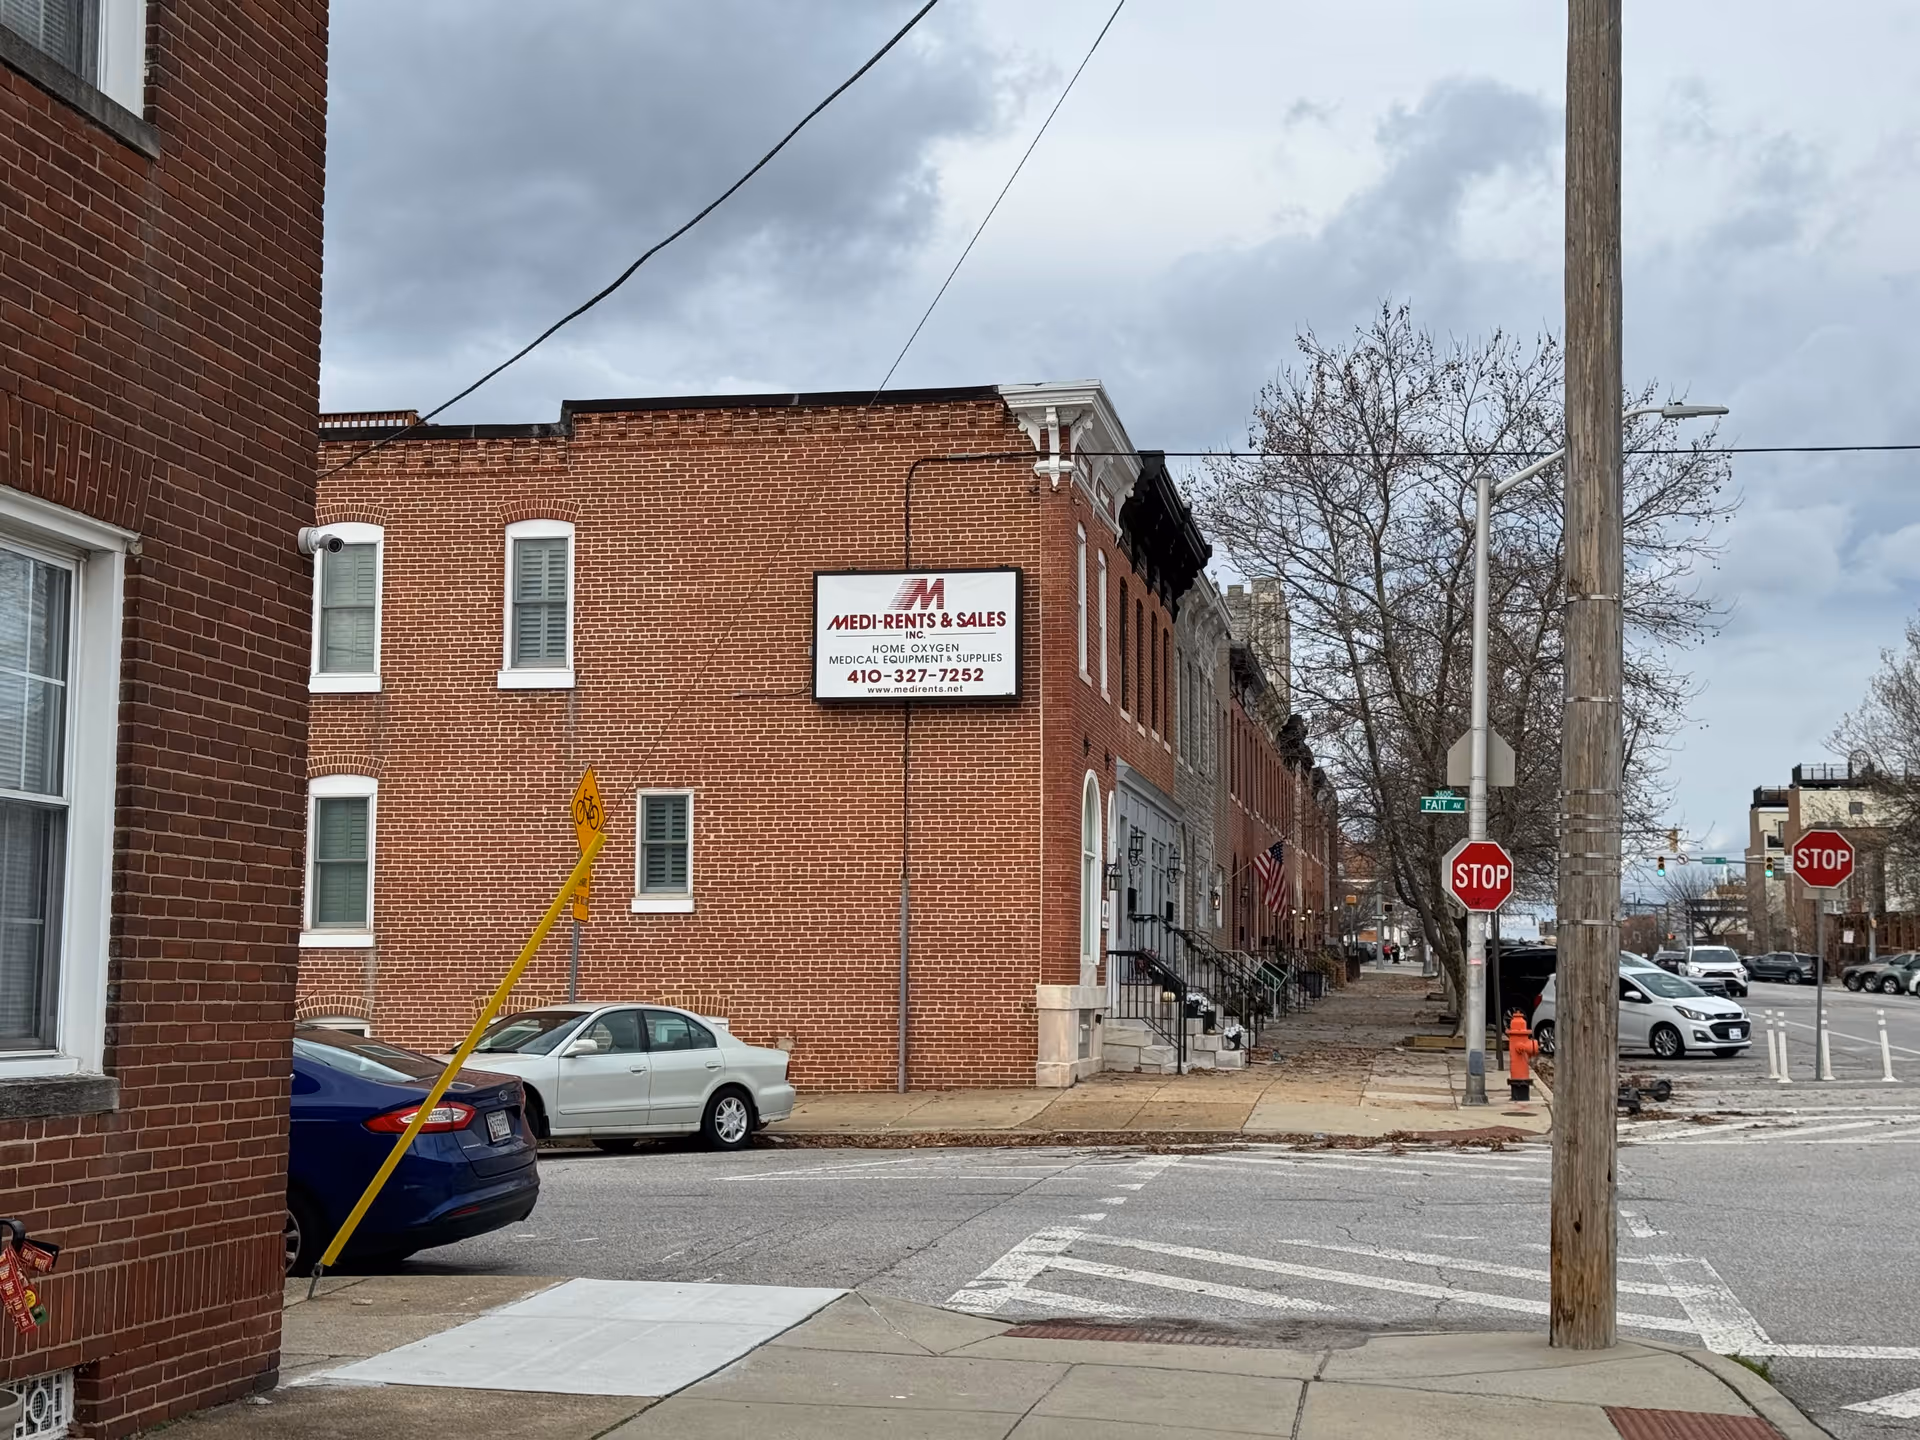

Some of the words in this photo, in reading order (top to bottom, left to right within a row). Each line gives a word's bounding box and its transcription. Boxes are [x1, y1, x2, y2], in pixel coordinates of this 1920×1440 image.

[887, 578, 945, 610] M
[826, 613, 936, 630] MEDI-RENTS
[940, 613, 953, 628] &
[956, 611, 1007, 627] SALES
[905, 631, 926, 640] INC.
[872, 645, 906, 653] HOME
[910, 643, 960, 653] OXYGEN
[829, 655, 879, 665] MEDICAL
[883, 654, 943, 664] EQUIPMENT
[956, 653, 1003, 663] SUPPLIES
[847, 668, 984, 684] 410-327-7252
[867, 685, 964, 694] www.medirents.net
[1425, 800, 1447, 810] FAIT
[1797, 848, 1850, 870] STOP
[1455, 863, 1509, 889] STOP
